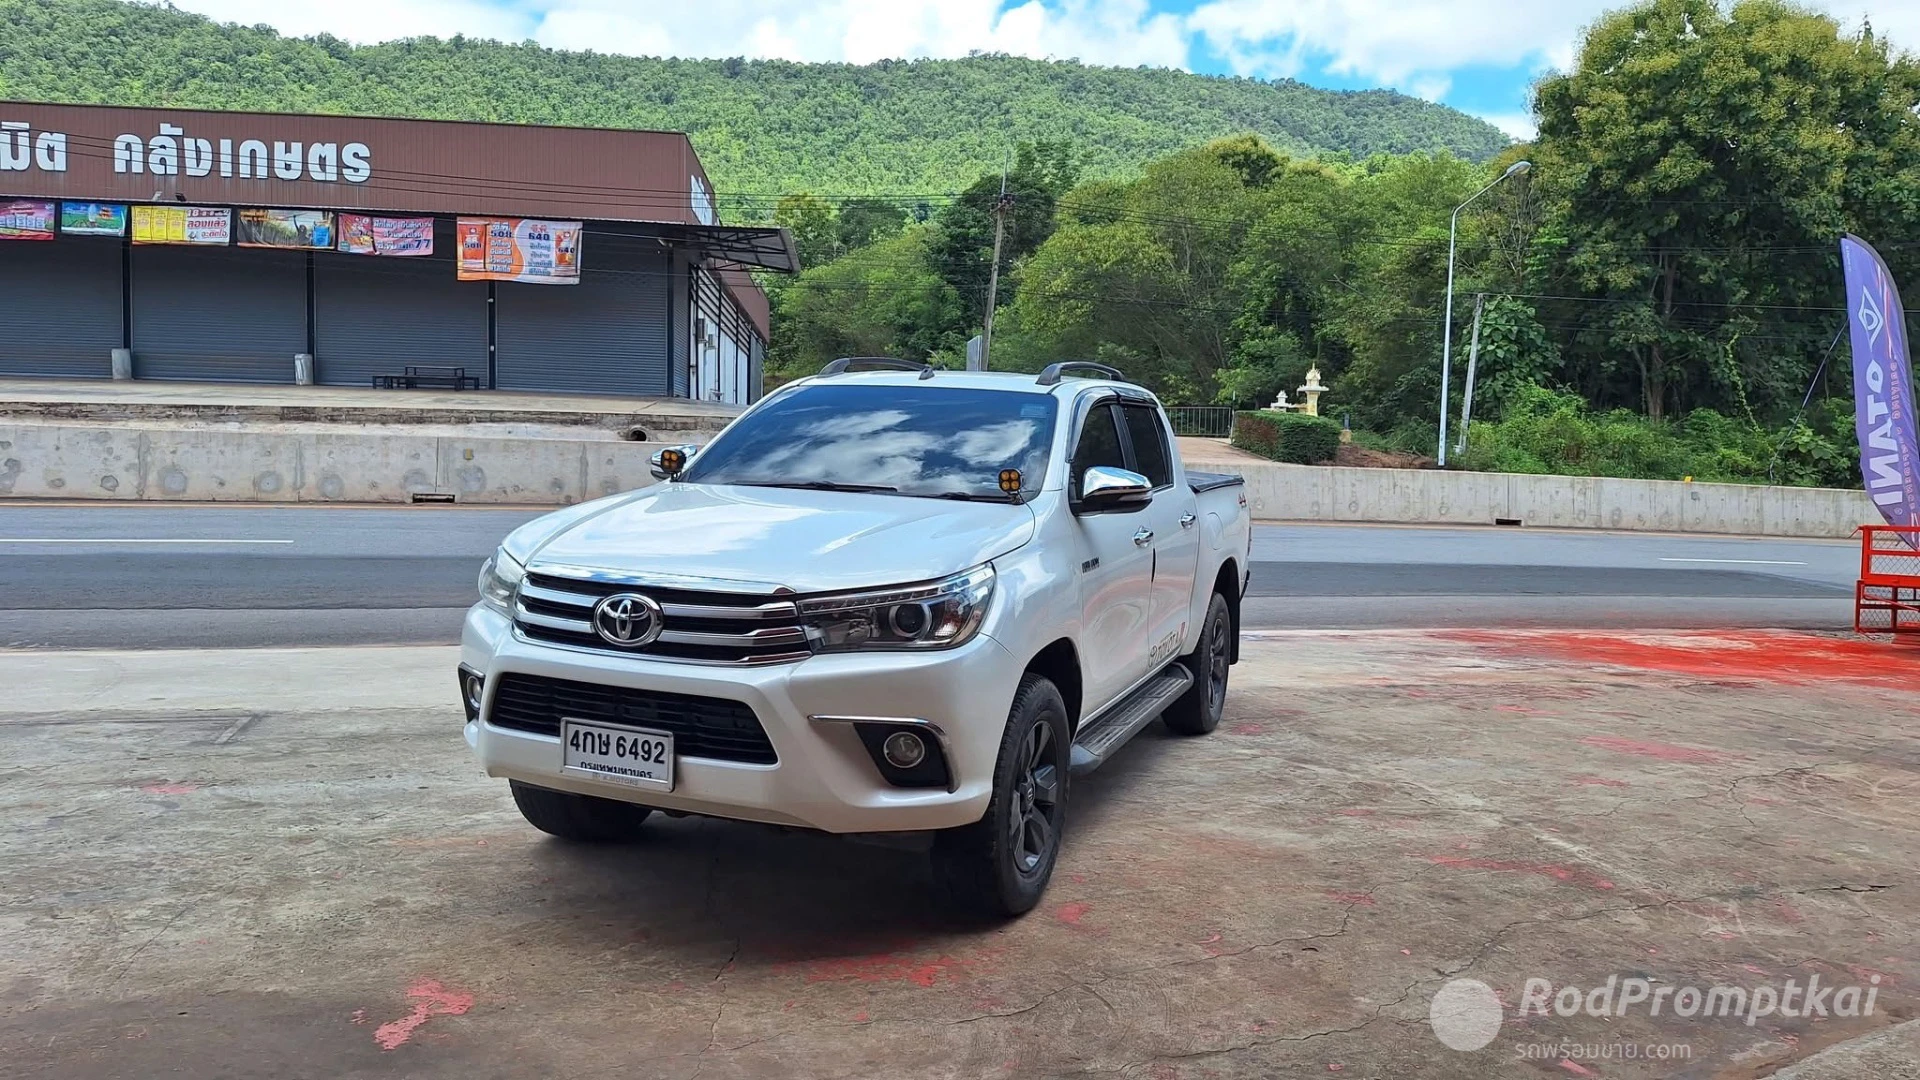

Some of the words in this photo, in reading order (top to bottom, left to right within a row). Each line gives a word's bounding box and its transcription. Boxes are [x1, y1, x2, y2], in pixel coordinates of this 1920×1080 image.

[114, 123, 371, 183] คลังเกษตร
[570, 729, 611, 756] 4กษ
[616, 735, 665, 765] 6492
[580, 761, 653, 779] กรงเทพมหานคร
